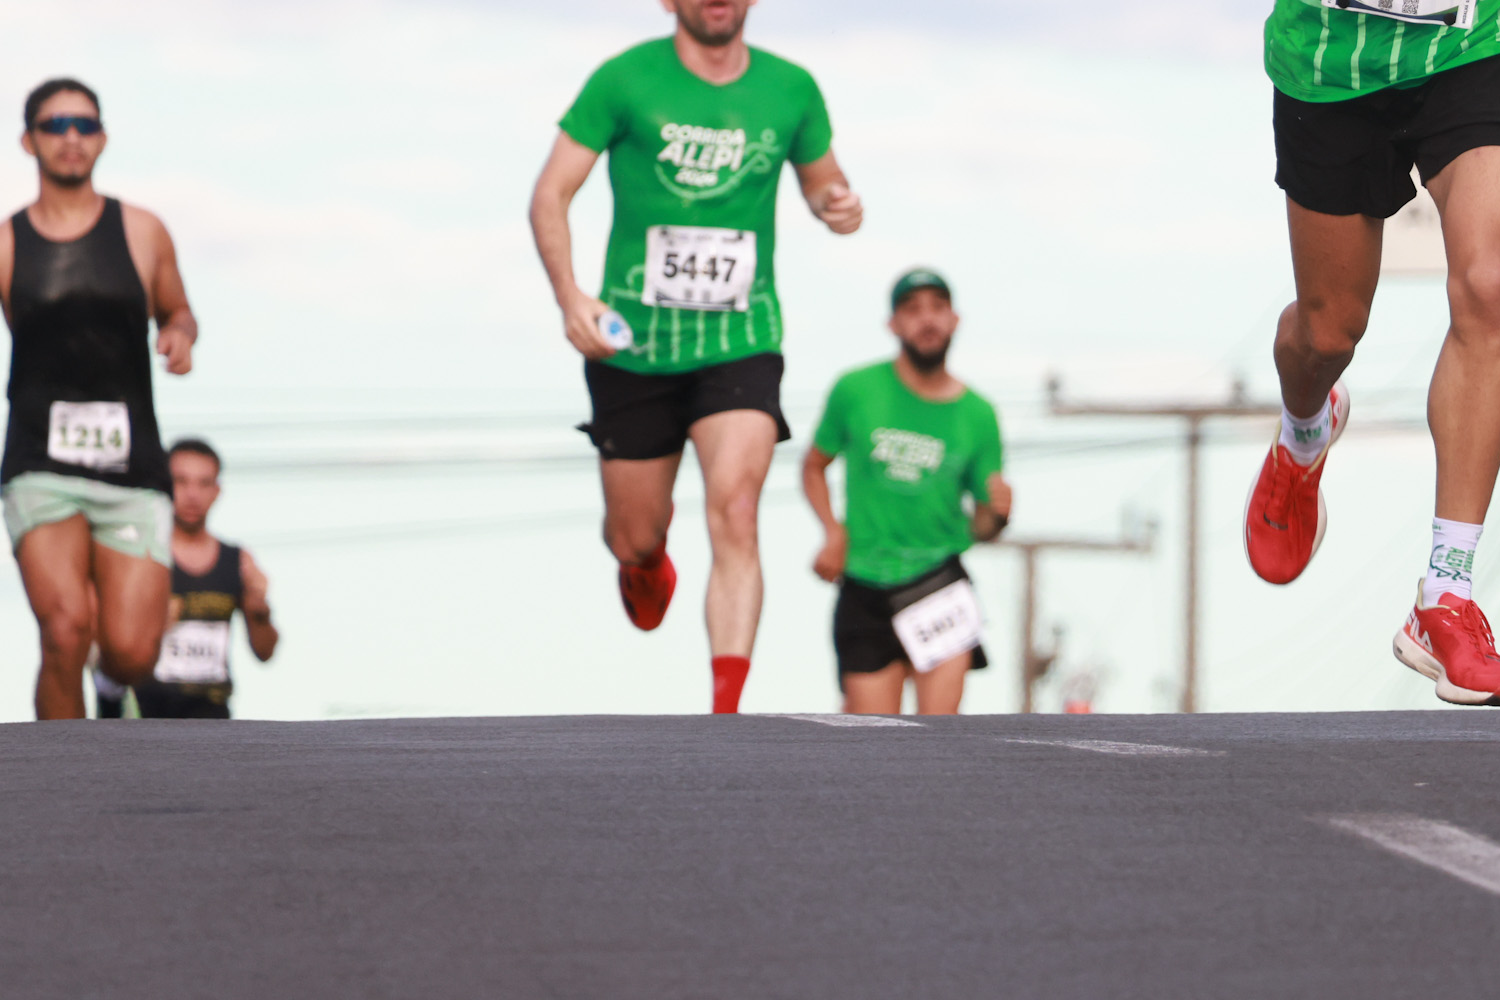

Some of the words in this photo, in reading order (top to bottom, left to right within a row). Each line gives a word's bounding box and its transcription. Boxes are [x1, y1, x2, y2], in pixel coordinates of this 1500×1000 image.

[657, 140, 744, 172] ALEPI
[663, 253, 737, 283] 5447
[59, 424, 122, 450] 1214
